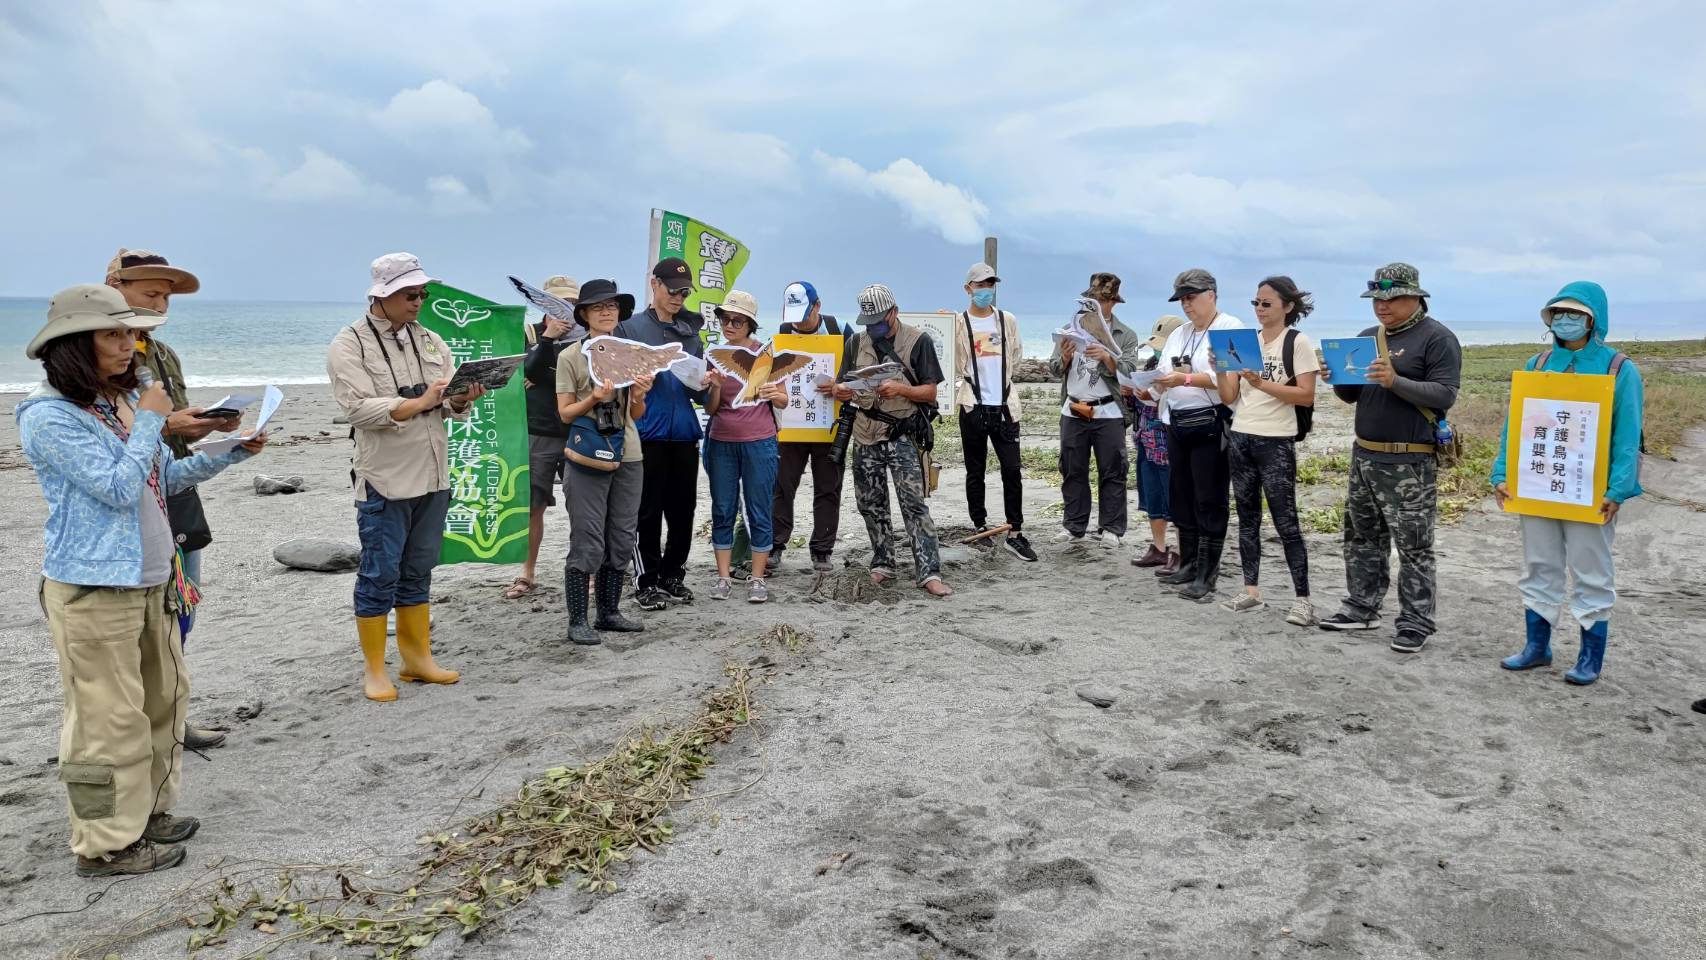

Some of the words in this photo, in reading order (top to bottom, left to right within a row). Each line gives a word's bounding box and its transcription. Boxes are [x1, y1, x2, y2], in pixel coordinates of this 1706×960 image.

[443, 338, 483, 535] 荒保護協會
[483, 389, 497, 424] CIETY
[485, 429, 498, 448] OF
[1530, 425, 1548, 475] 育嬰地
[1550, 410, 1571, 494] 守護鳥兒的
[486, 452, 500, 535] WILDERNESS
